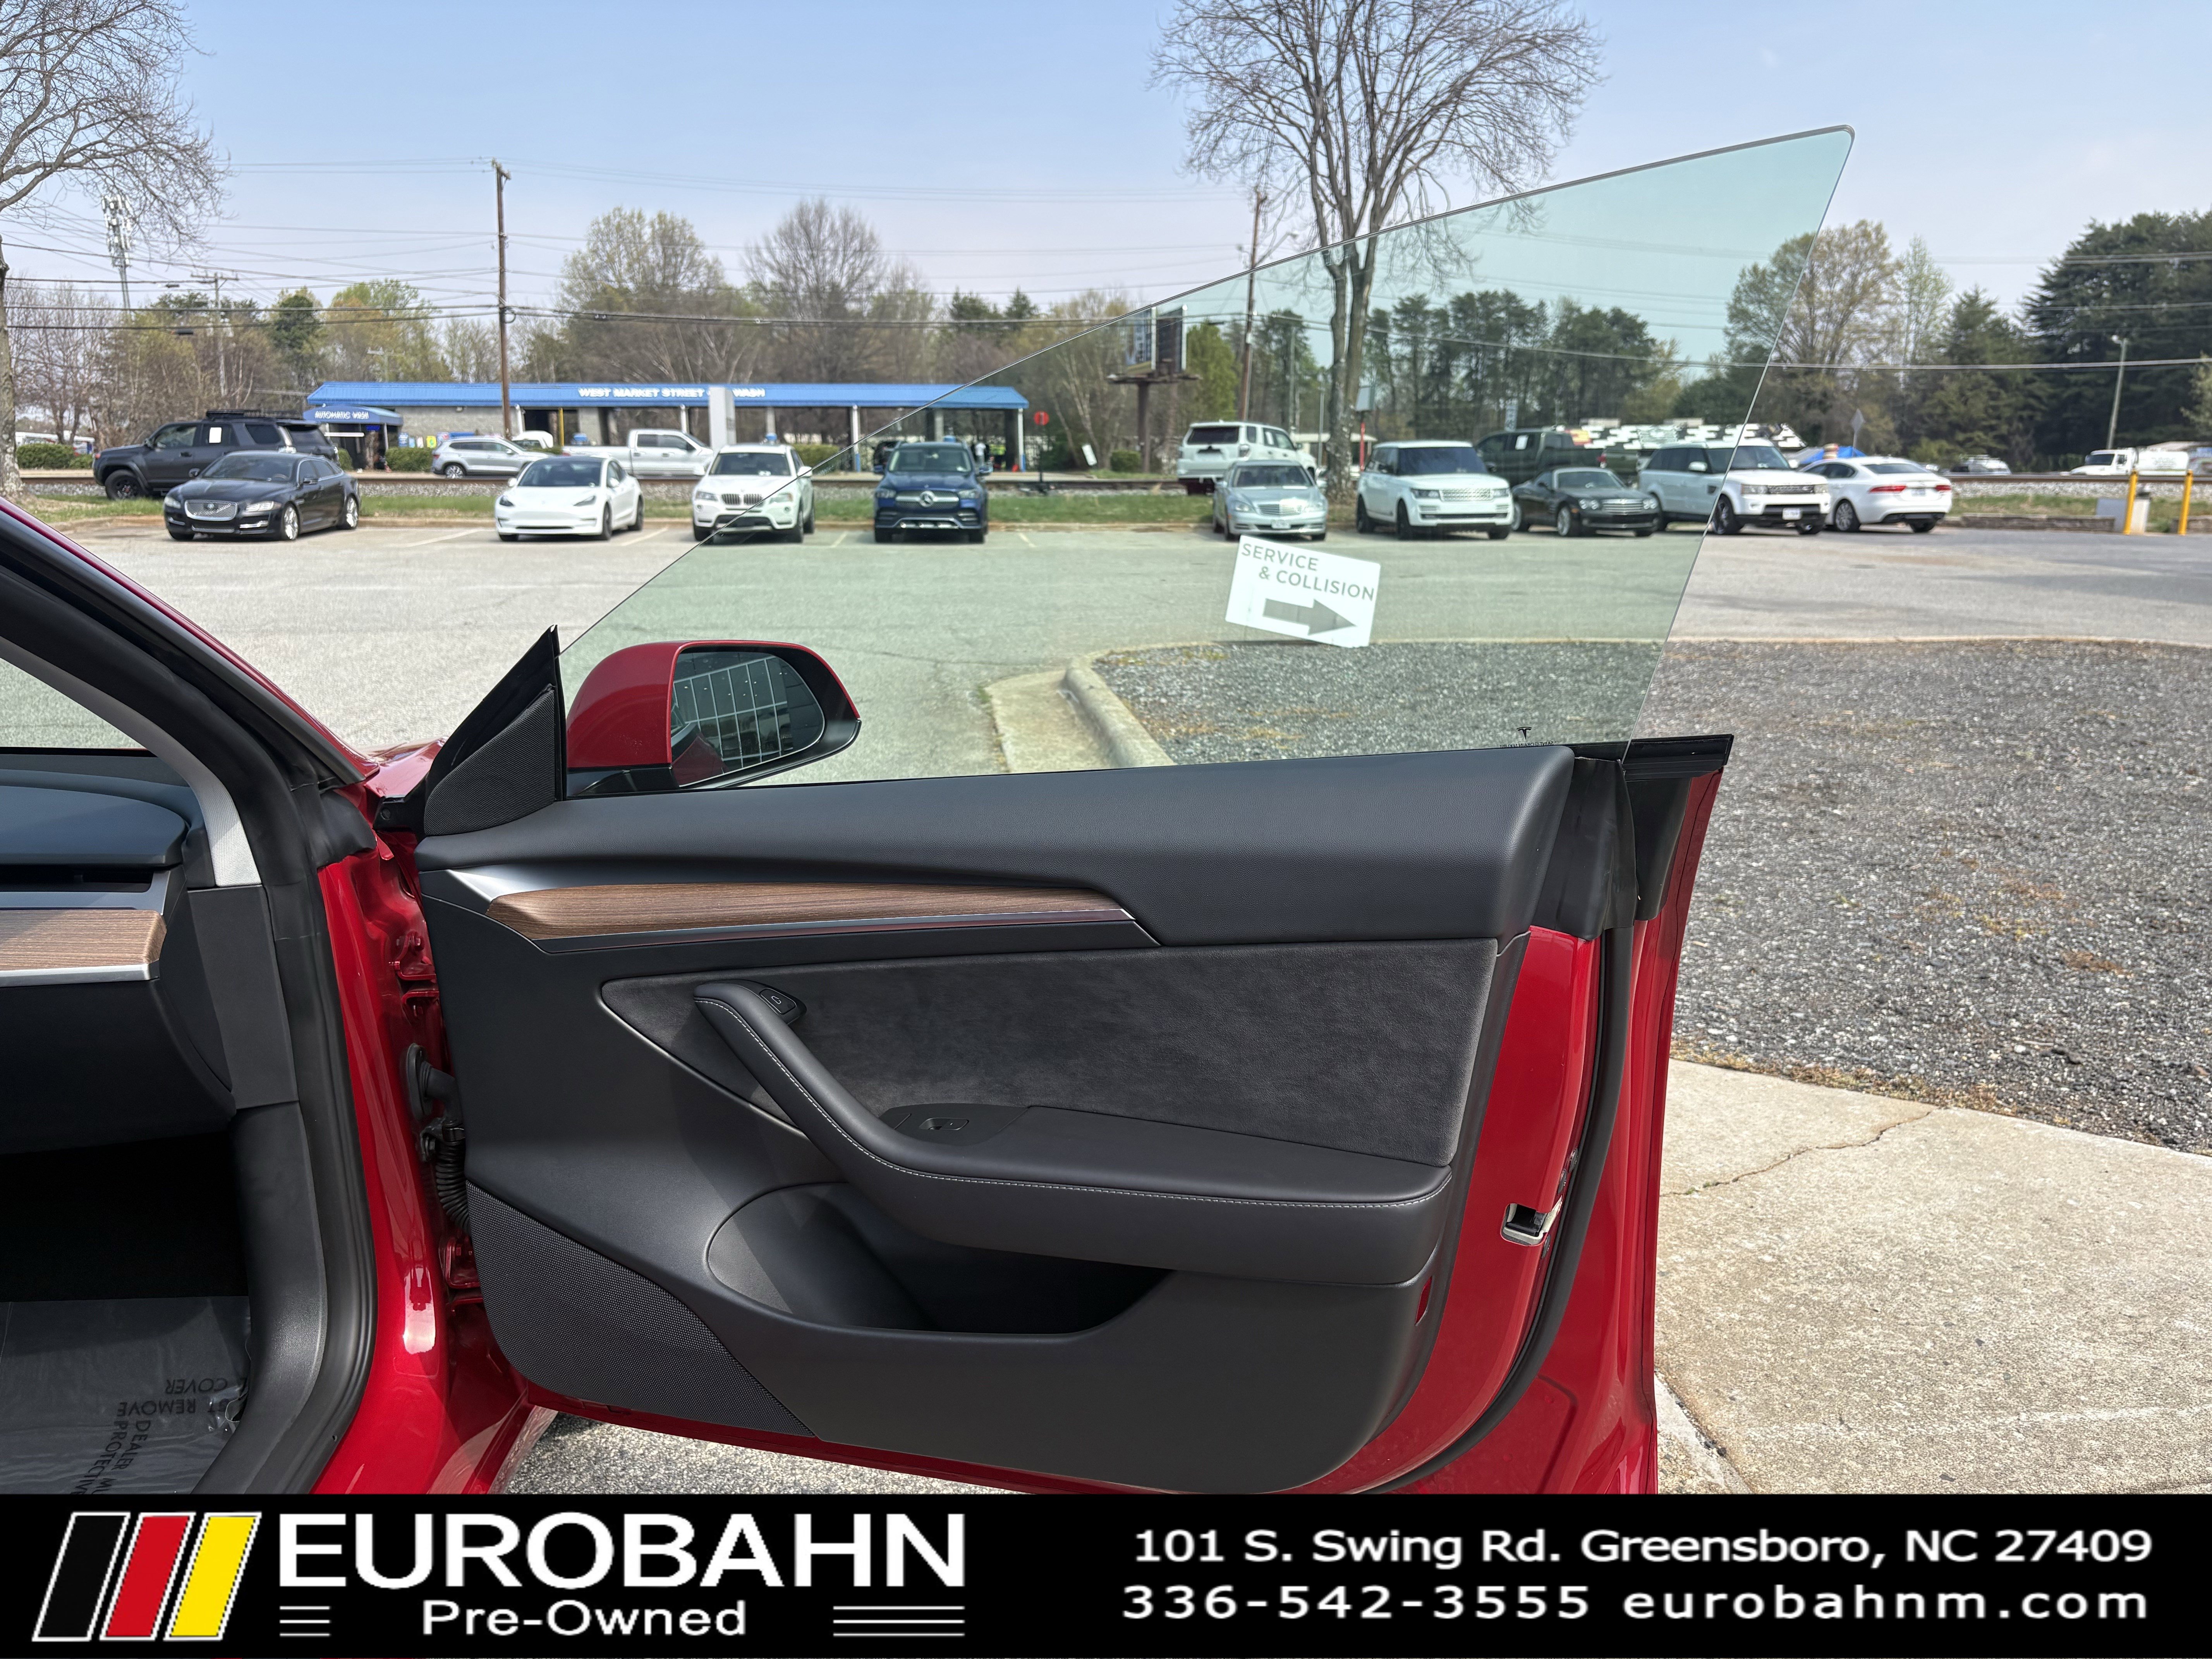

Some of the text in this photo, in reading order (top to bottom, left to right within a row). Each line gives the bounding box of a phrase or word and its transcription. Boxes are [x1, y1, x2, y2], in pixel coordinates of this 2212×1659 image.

[578, 388, 611, 397] WEST
[613, 388, 659, 397] MARKET
[661, 388, 704, 397] STREET
[315, 410, 369, 419] AUTOMATIC WASH
[1241, 543, 1319, 571] SERVICE
[1259, 566, 1374, 601] & COLLISION
[165, 1377, 227, 1394] COVER
[117, 1399, 196, 1417] REMOVE
[113, 1420, 150, 1470] DEALER
